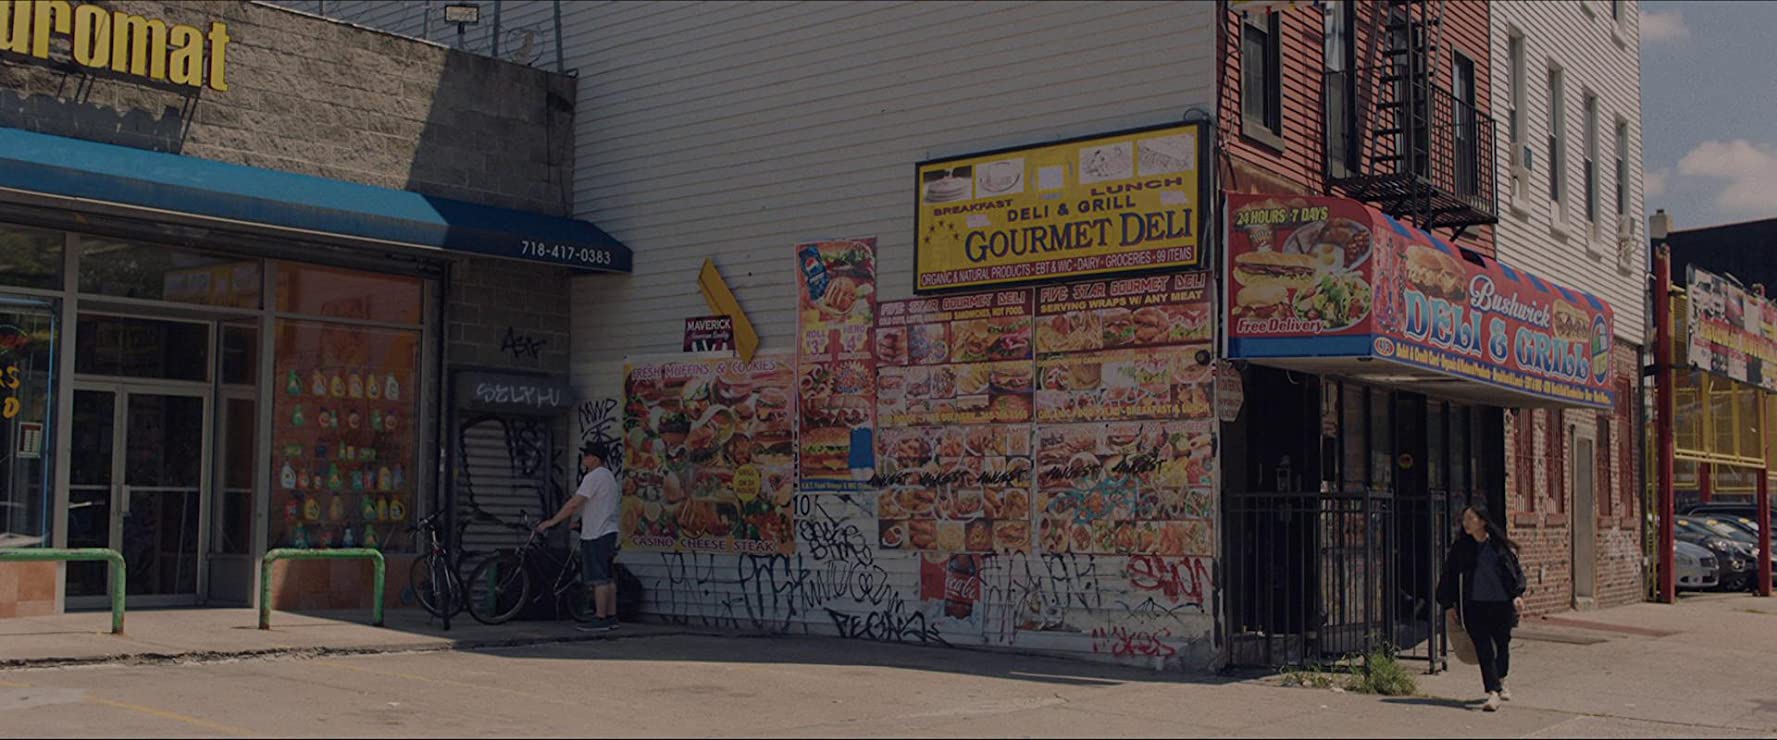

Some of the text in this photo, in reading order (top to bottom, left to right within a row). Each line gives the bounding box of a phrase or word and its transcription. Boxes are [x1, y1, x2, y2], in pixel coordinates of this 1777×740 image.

[1091, 177, 1182, 196] LUNCH
[933, 200, 1013, 217] BREAKFAST
[1007, 195, 1136, 222] DELI & GRILL
[1236, 206, 1328, 225] 24 HOURS 7 DAYS
[965, 208, 1192, 263] GOURMET DELI
[521, 240, 611, 265] 718-417-0383
[921, 272, 952, 286] ORGANIC
[960, 268, 990, 282] NATURAL
[991, 263, 1031, 279] PRODUCTS
[1036, 261, 1050, 275] EBT
[1057, 259, 1073, 273] WIC
[1077, 256, 1100, 271] DAIRY
[1105, 251, 1151, 268] GROCERIES
[1156, 250, 1166, 263] 99
[1167, 247, 1193, 261] ITEMS
[1040, 273, 1206, 303] FIVE STAR GOURMET DELI
[908, 299, 939, 313] STAR
[942, 293, 994, 311] GOURMET
[997, 291, 1026, 305] DELI
[1040, 290, 1203, 314] SERVING WRAPS W/ ANY MEAT
[1470, 274, 1550, 328] Bushwick
[687, 319, 731, 331] MAVERICK
[1237, 317, 1324, 334] Free Delivery
[1403, 287, 1590, 384] DELI & GRILL
[632, 366, 662, 379] FRESH
[664, 363, 709, 377] MUFFINS
[716, 362, 727, 374] &
[793, 495, 810, 516] 10
[632, 535, 774, 552] CASINO CHEESE STEAK
